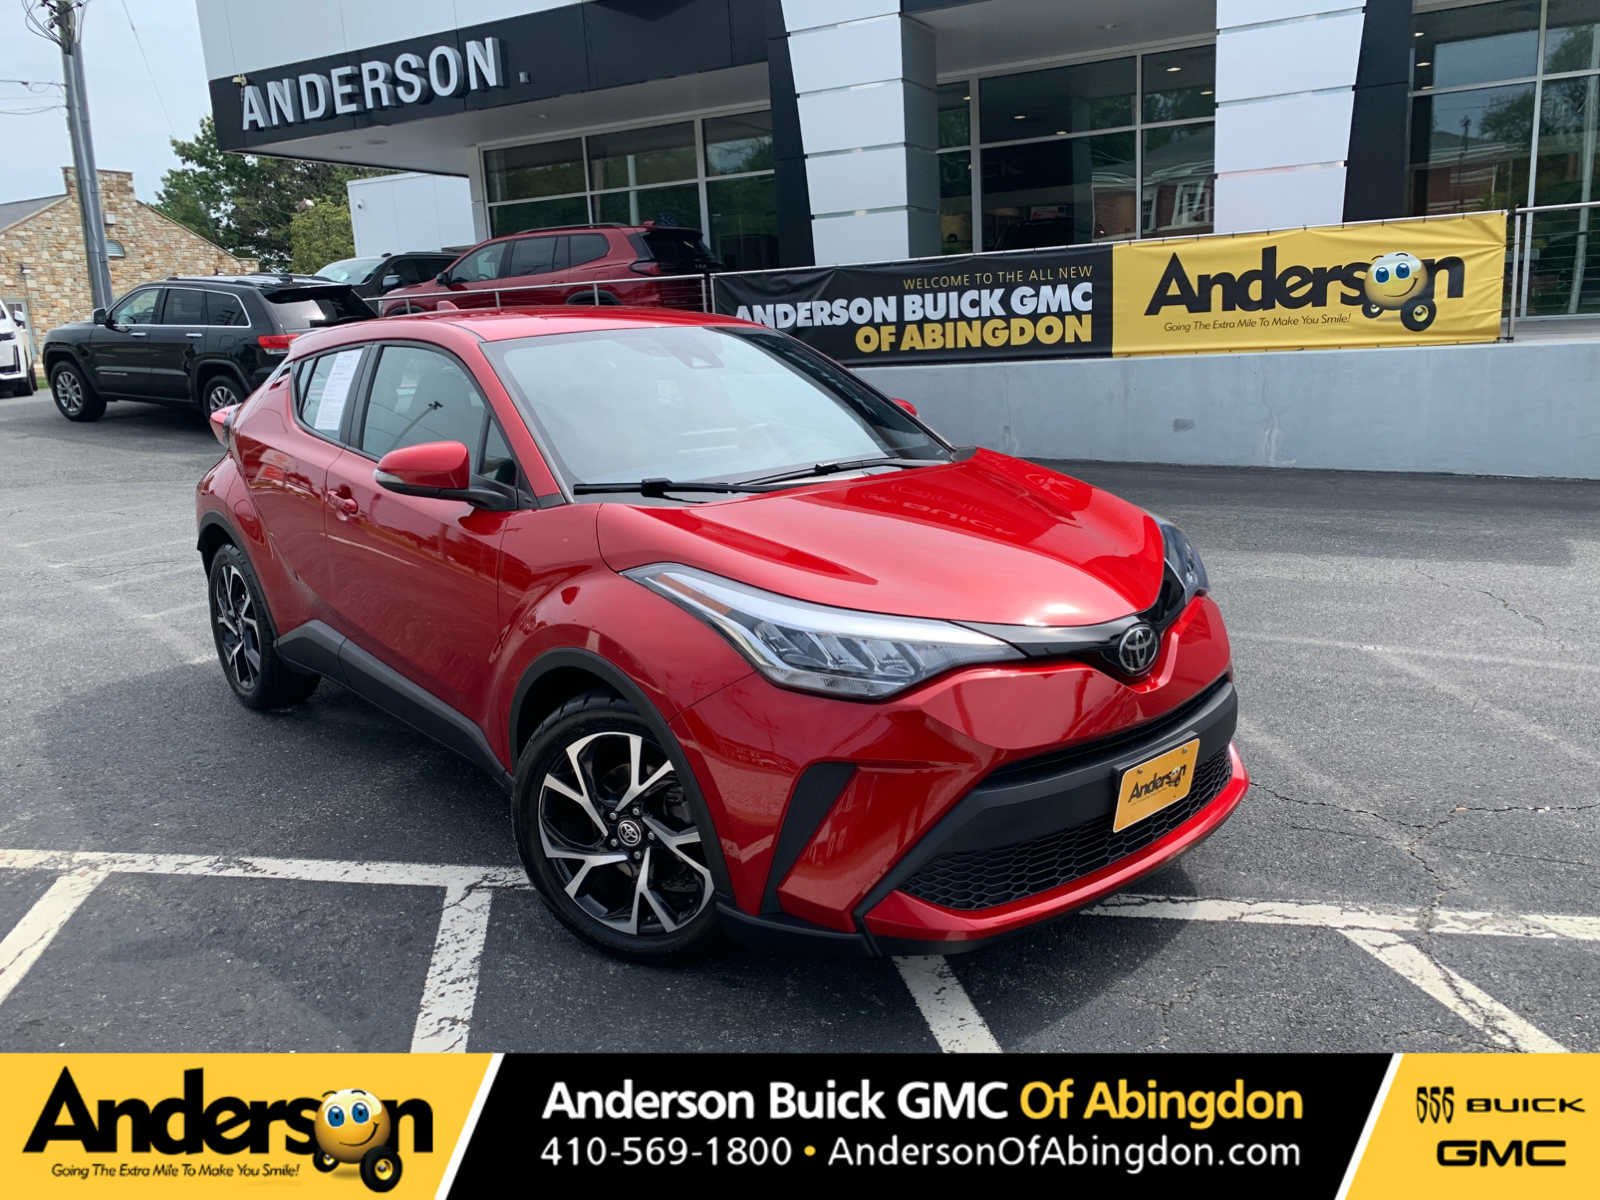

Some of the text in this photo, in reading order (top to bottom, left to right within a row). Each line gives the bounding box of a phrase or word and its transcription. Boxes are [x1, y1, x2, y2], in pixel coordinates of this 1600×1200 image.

[242, 37, 502, 130] ANDERSON
[903, 265, 1093, 290] WELCOME TO THE ALL NEW
[735, 281, 1093, 330] ANDERSON BUICK GMC
[1163, 312, 1352, 333] Going The Extra Mile To Make You Smile!
[855, 314, 1093, 353] OF ABINGDON
